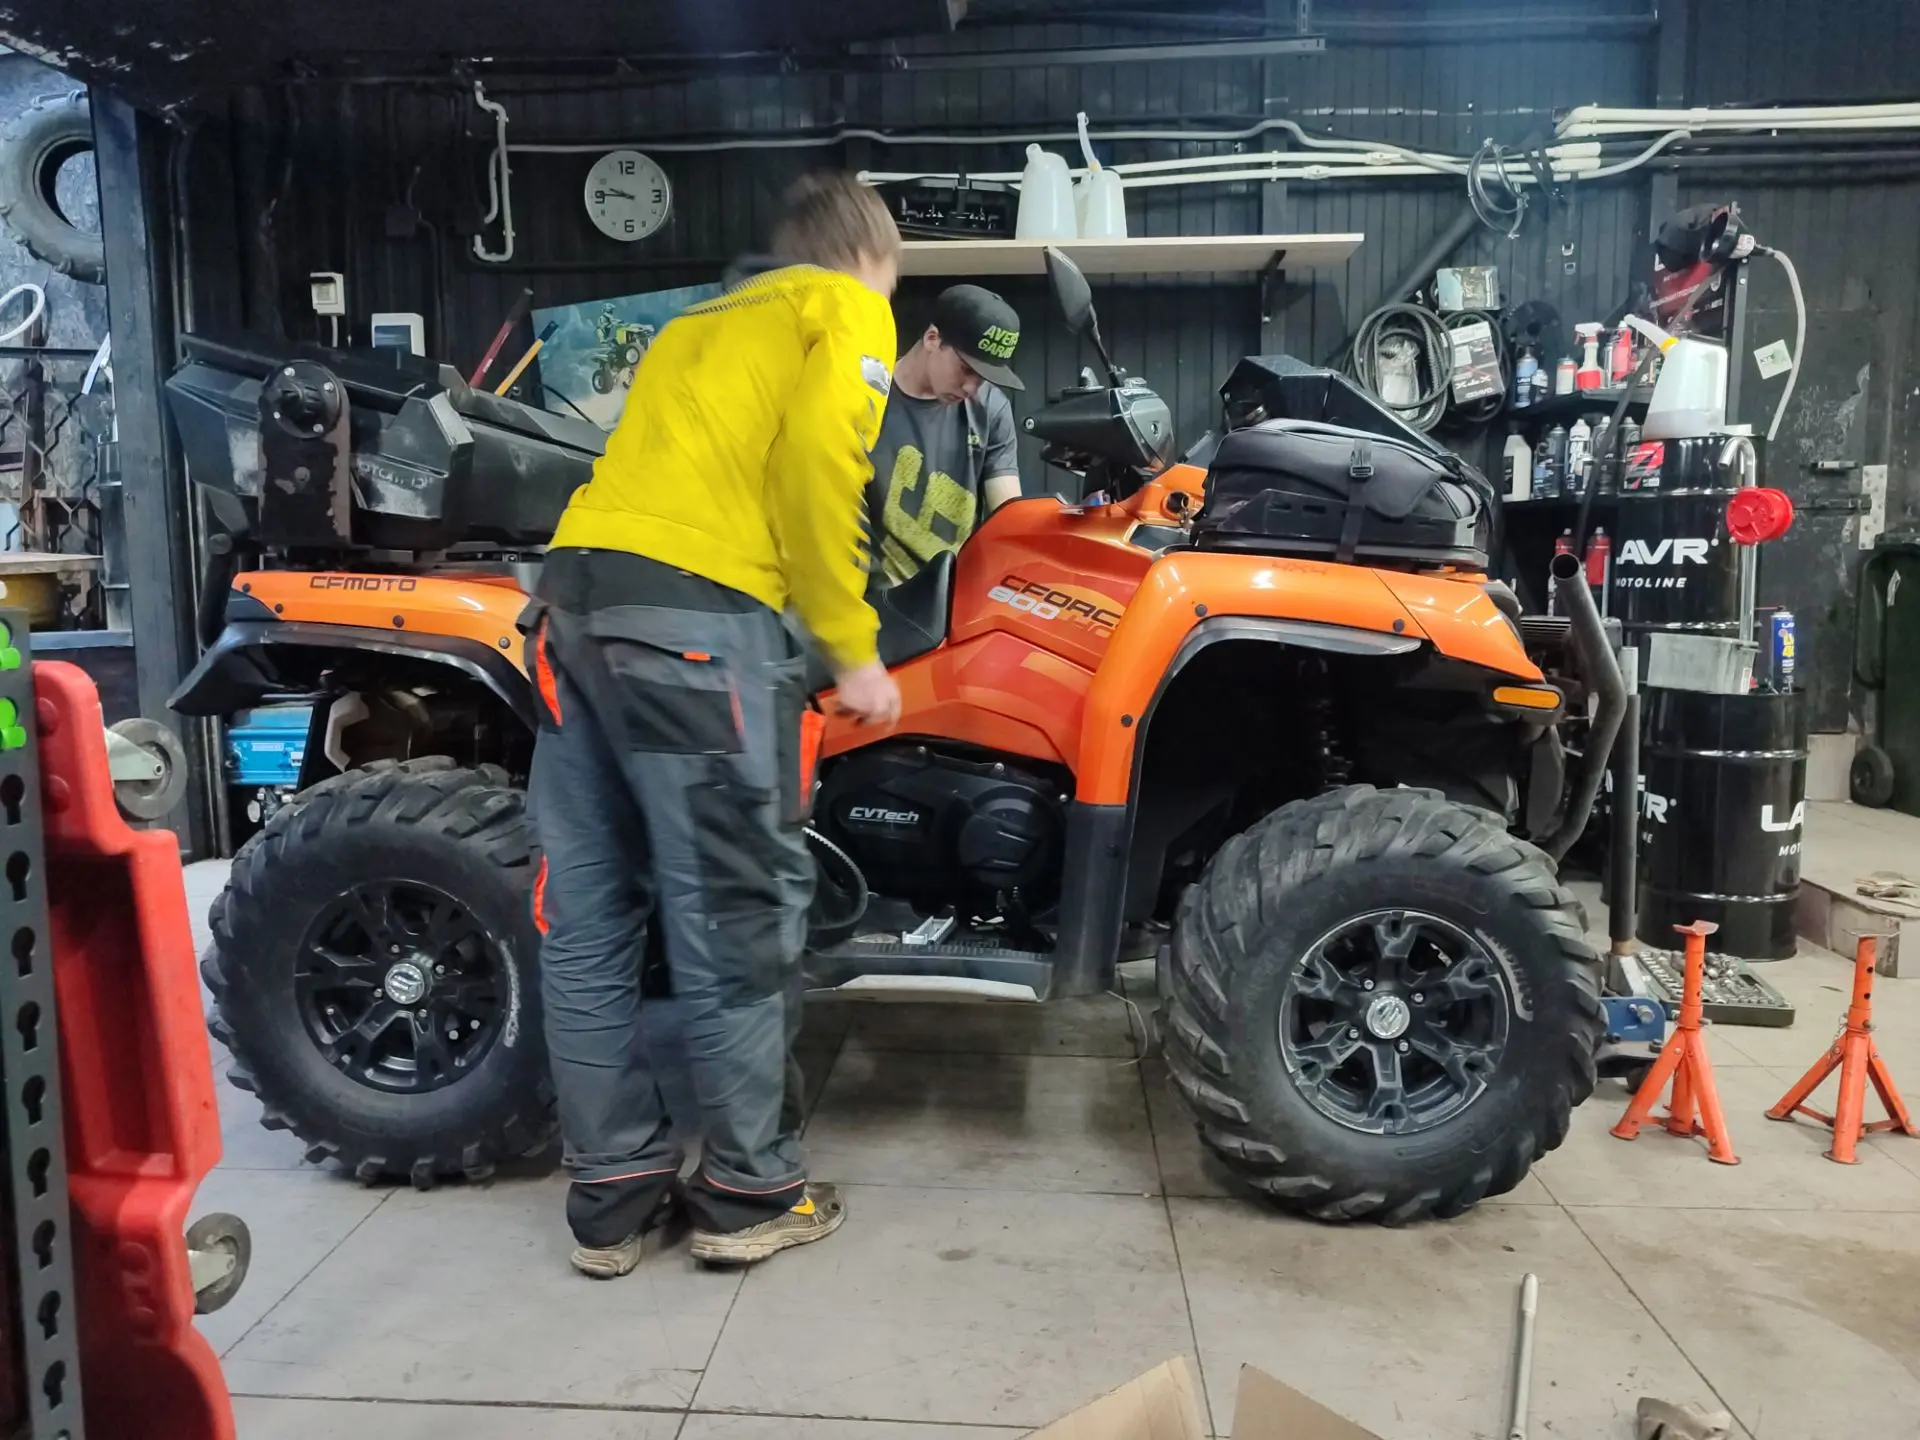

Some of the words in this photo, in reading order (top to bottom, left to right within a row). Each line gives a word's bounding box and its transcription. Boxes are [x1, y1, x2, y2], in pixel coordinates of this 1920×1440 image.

[618, 161, 635, 175] 12
[595, 190, 605, 204] 9
[651, 189, 662, 203] 3
[624, 220, 635, 233] 6
[1616, 538, 1708, 565] AVR
[310, 575, 417, 592] CFMOTO
[987, 585, 1061, 620] 800
[1000, 574, 1122, 628] CFORC
[850, 806, 920, 822] CVTech
